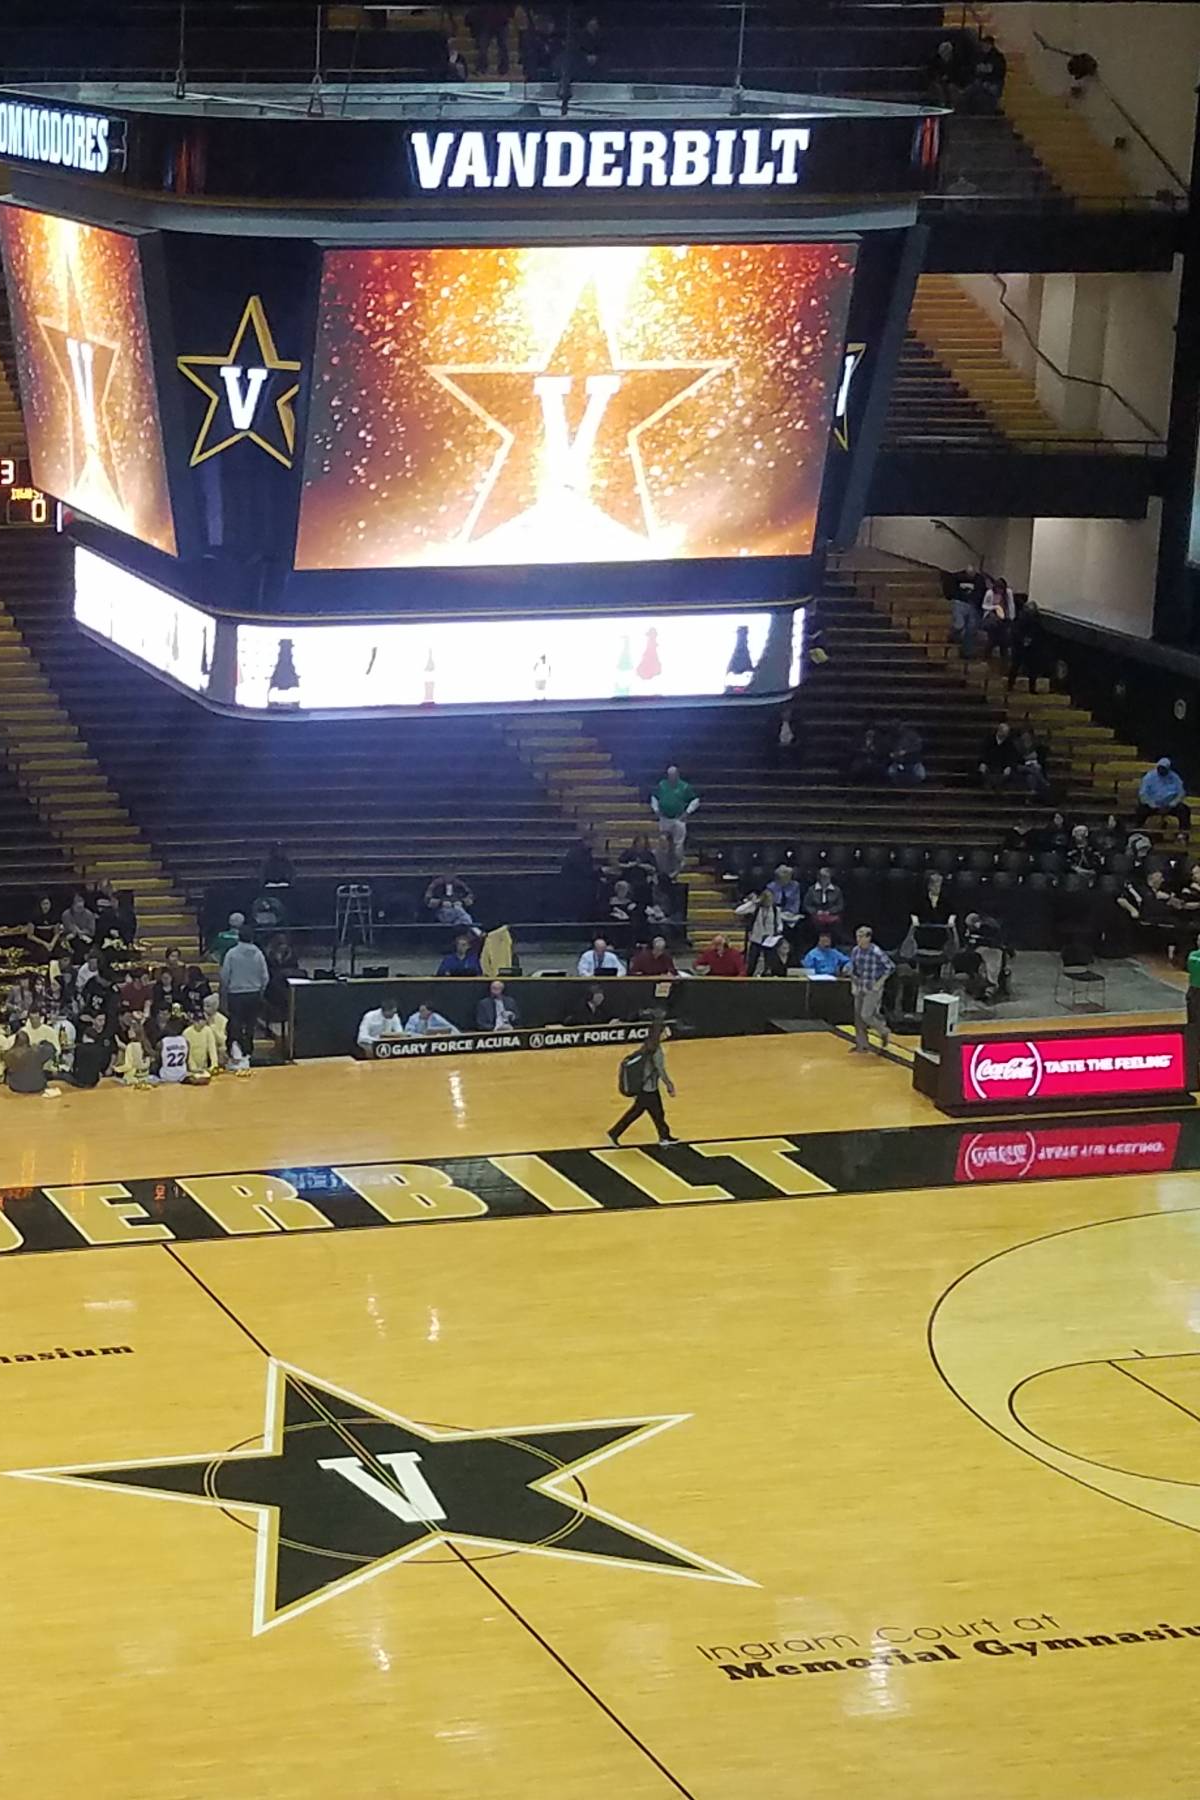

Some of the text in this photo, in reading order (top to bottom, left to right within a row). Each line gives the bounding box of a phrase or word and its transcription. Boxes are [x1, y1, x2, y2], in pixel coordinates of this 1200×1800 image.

[410, 128, 810, 189] VANDERBILT
[220, 366, 267, 429] V
[31, 500, 46, 522] 0
[392, 1036, 520, 1055] GARY FORCE ACURA
[545, 1034, 580, 1045] GARY
[584, 1031, 625, 1043] FORCE
[166, 1052, 186, 1067] 22
[1043, 1060, 1085, 1073] TASTE
[1086, 1058, 1113, 1071] THE
[1114, 1055, 1173, 1070] FEELING
[316, 1451, 448, 1523] V
[695, 1612, 1062, 1662] Ingram Court at
[717, 1643, 963, 1681] Memorial
